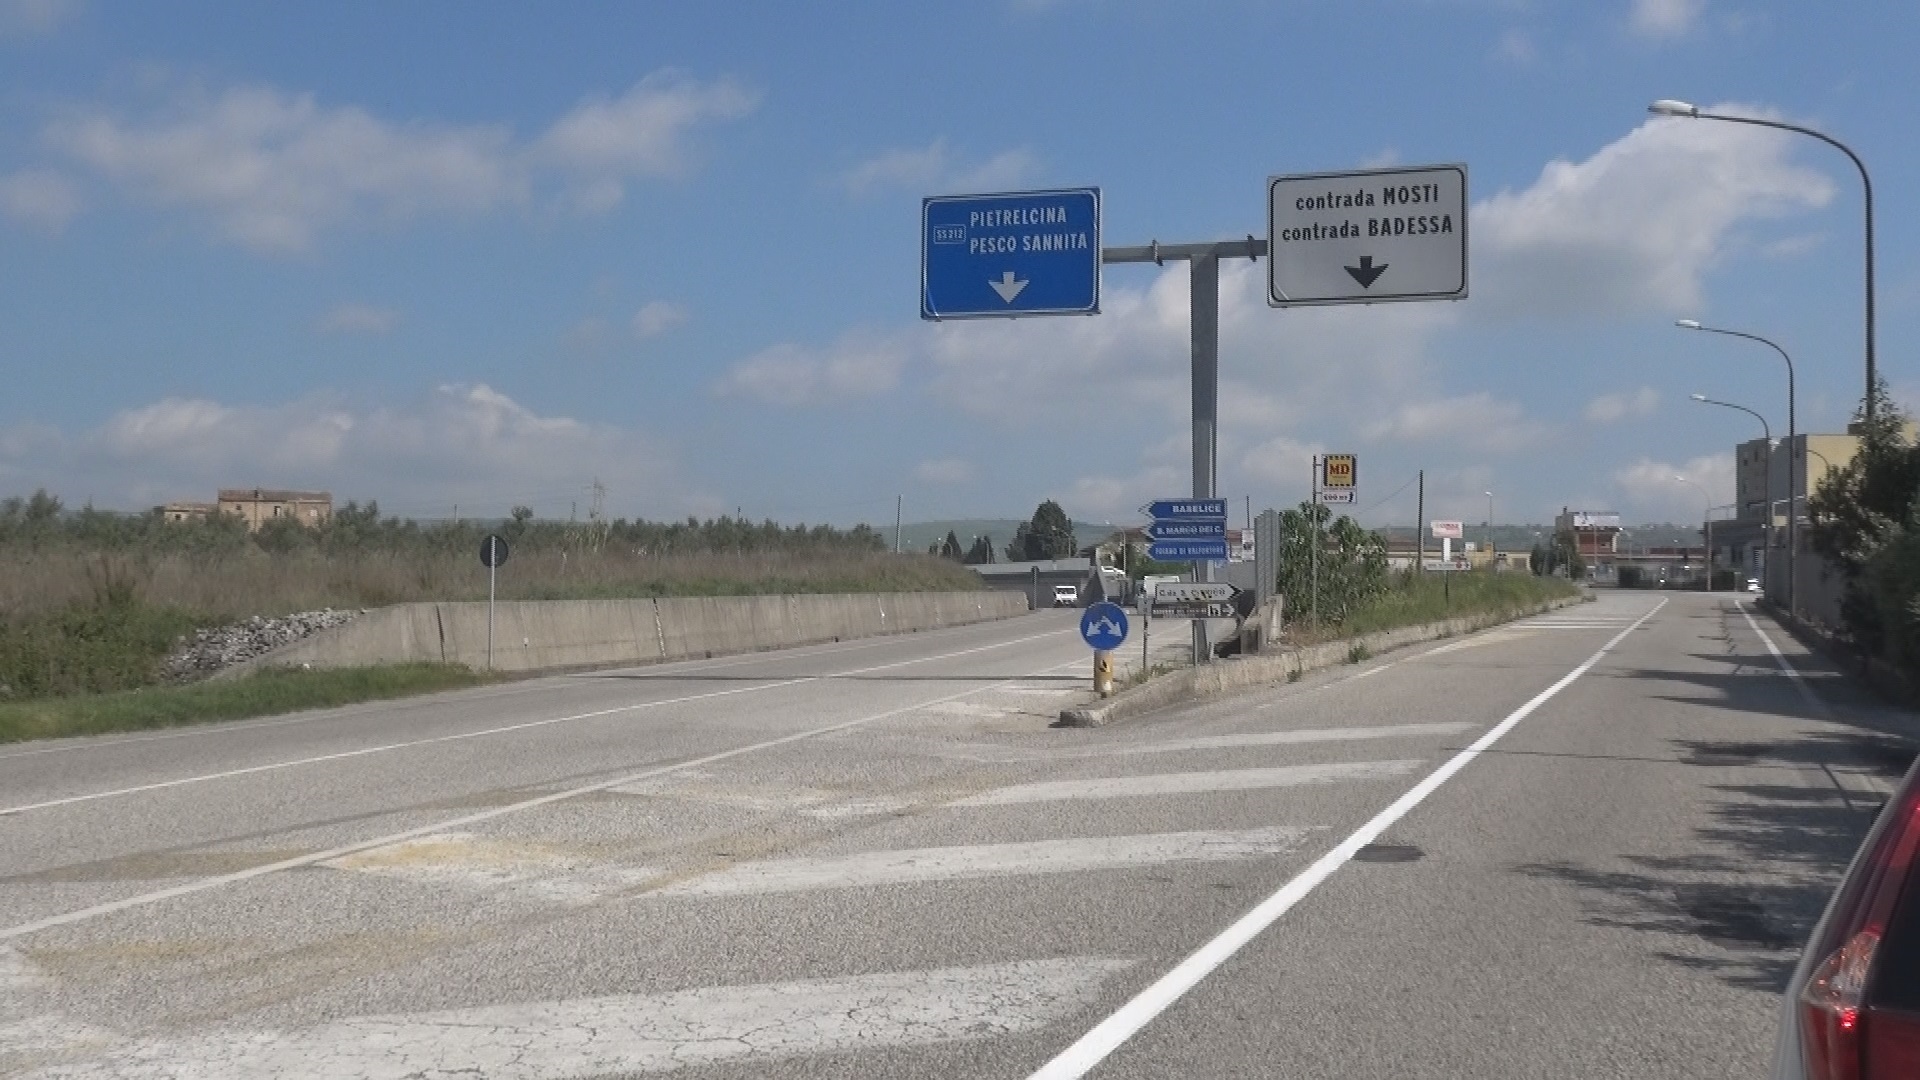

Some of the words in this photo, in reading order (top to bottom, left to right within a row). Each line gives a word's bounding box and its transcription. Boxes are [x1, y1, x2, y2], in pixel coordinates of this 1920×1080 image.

[1295, 188, 1375, 211] contrada
[1383, 183, 1439, 206] MOSTI
[970, 206, 1067, 228] PIETRELCINA
[1282, 219, 1360, 241] contrada
[1367, 214, 1453, 237] BADESSA
[970, 235, 1017, 255] PESCO
[1022, 231, 1087, 251] SANNITA
[1329, 463, 1350, 475] MD
[1172, 503, 1221, 513] BASELICE
[1166, 525, 1198, 535] MARCO
